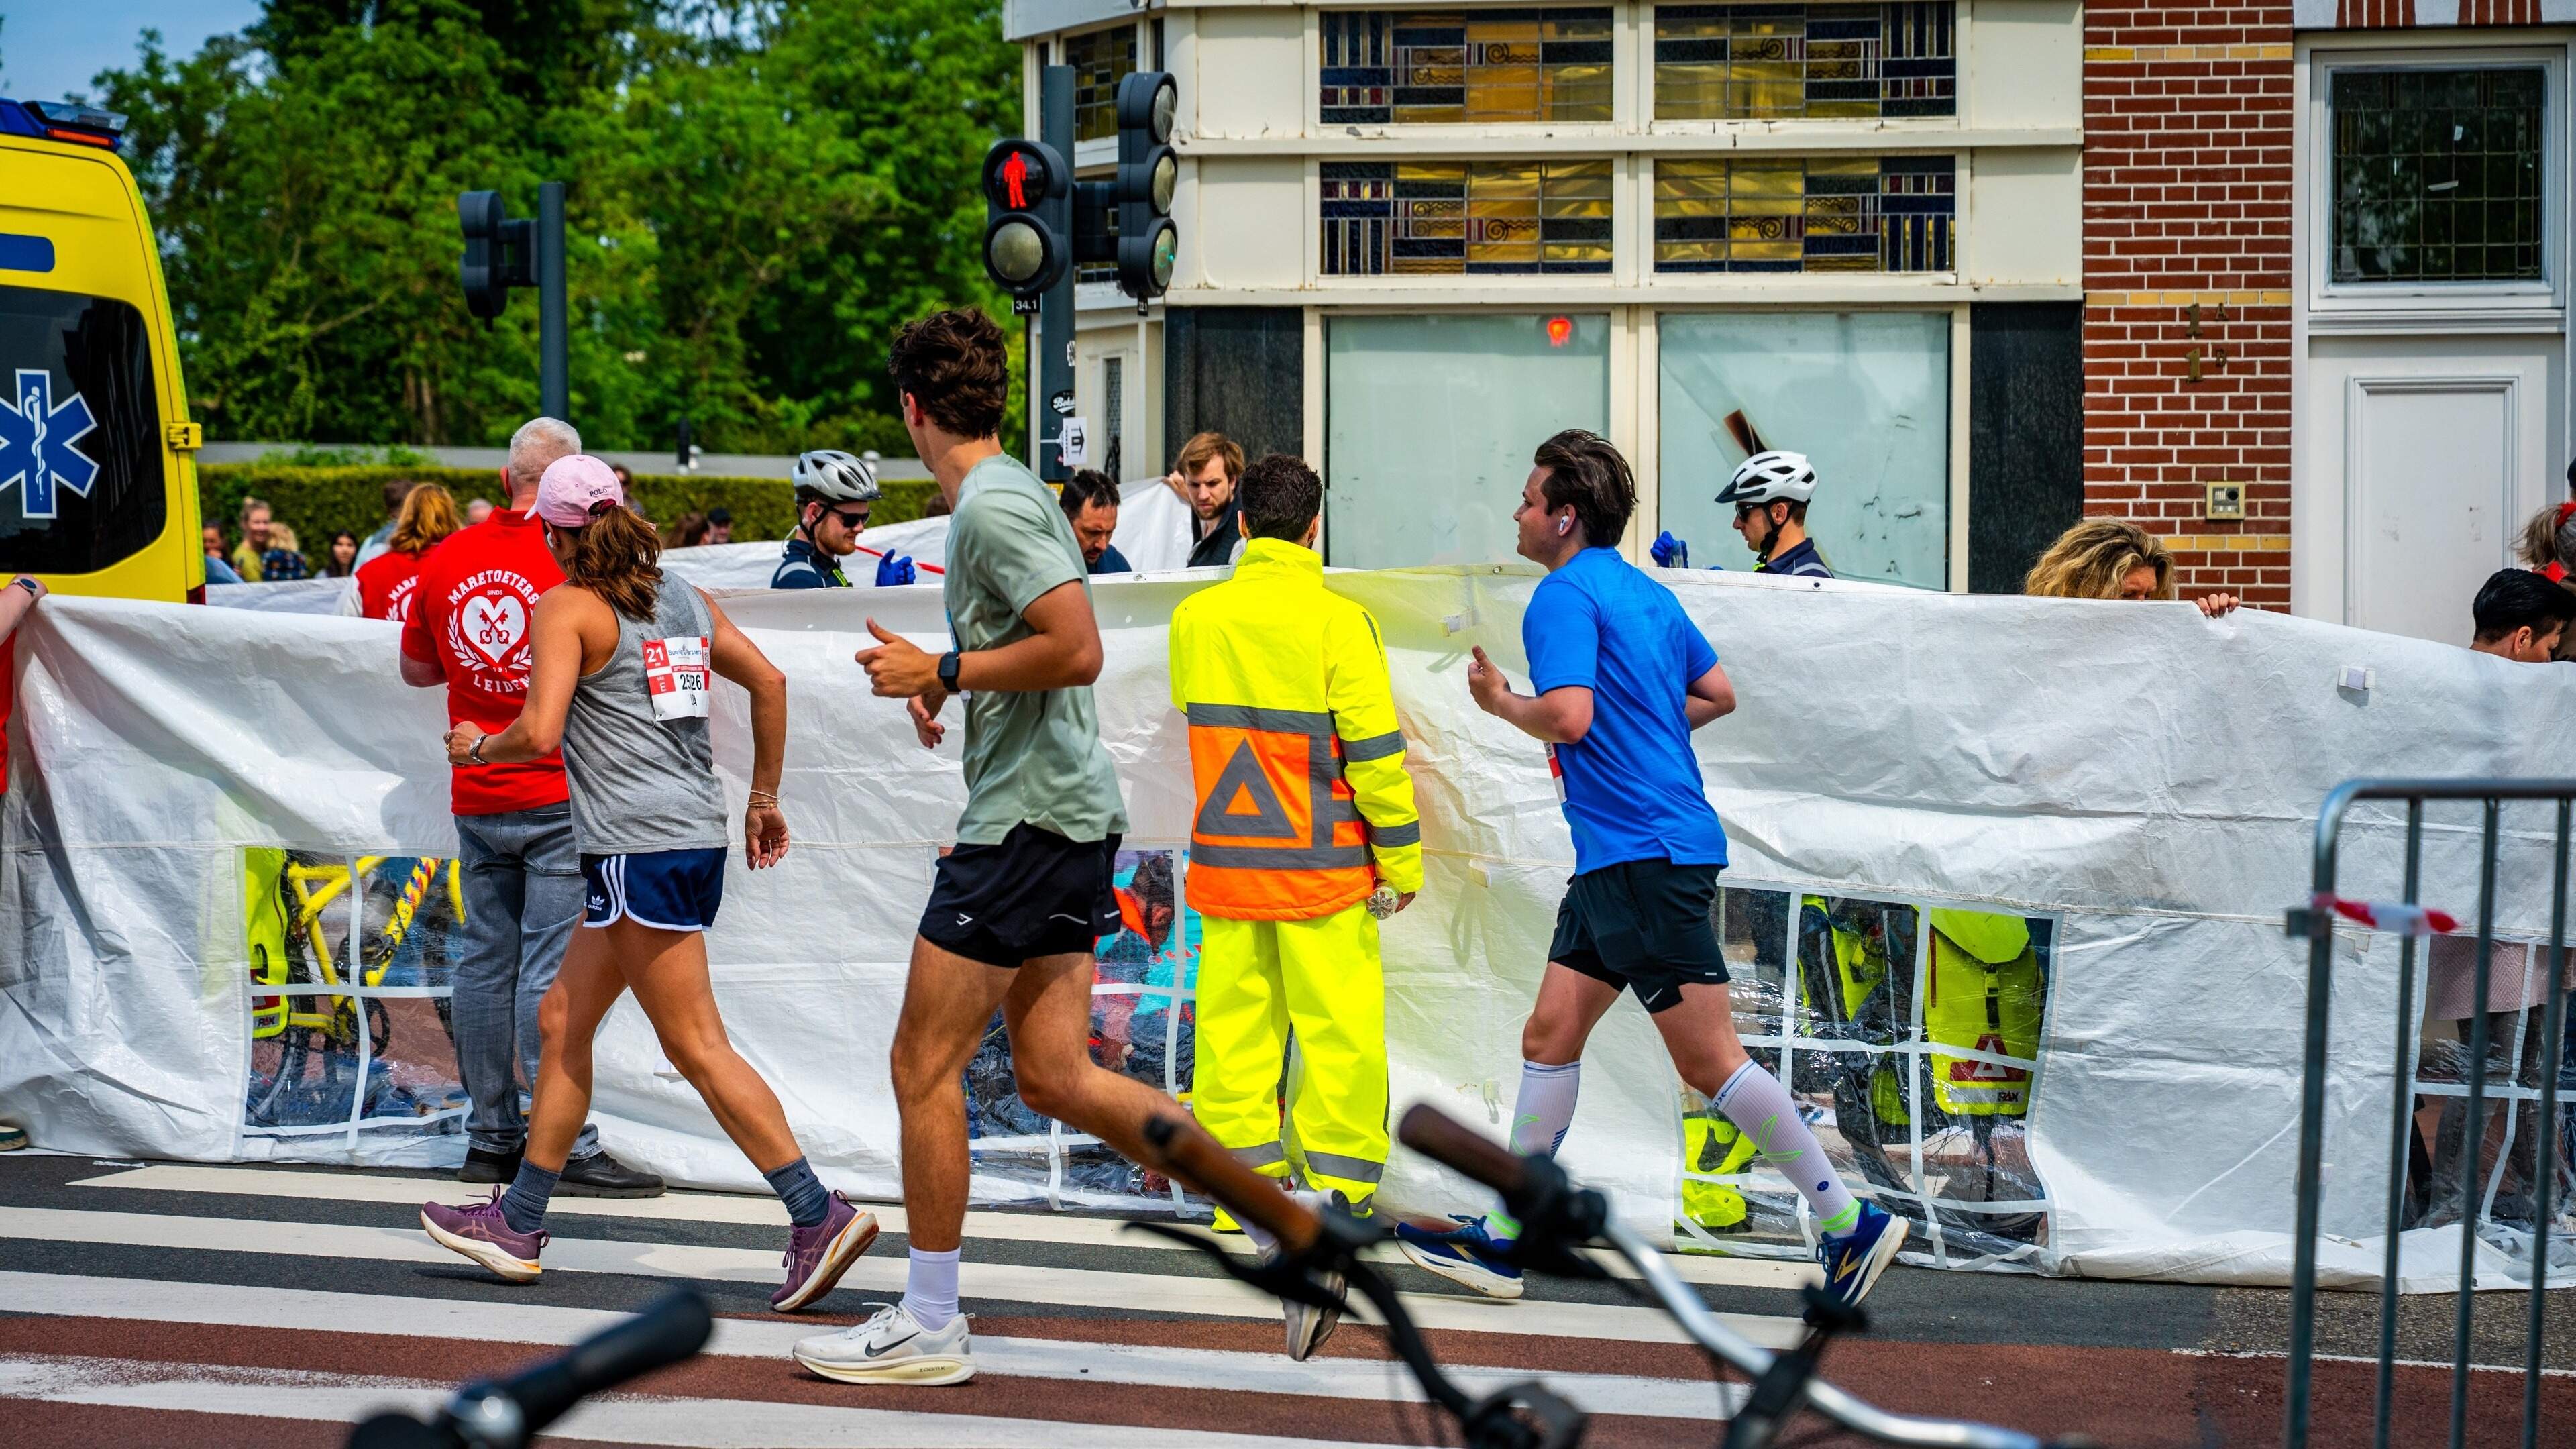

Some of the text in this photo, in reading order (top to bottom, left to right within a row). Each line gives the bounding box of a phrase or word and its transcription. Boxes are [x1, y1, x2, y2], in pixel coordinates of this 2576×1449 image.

[1016, 300, 1037, 311] 34.1
[589, 488, 607, 497] POLO
[447, 570, 539, 605] MARETOETERS
[646, 647, 664, 663] 21
[474, 674, 530, 693] LEIDEN
[660, 682, 667, 691] E
[680, 674, 702, 690] 2526
[258, 1016, 275, 1027] PAX
[1998, 1091, 2018, 1102] PAX
